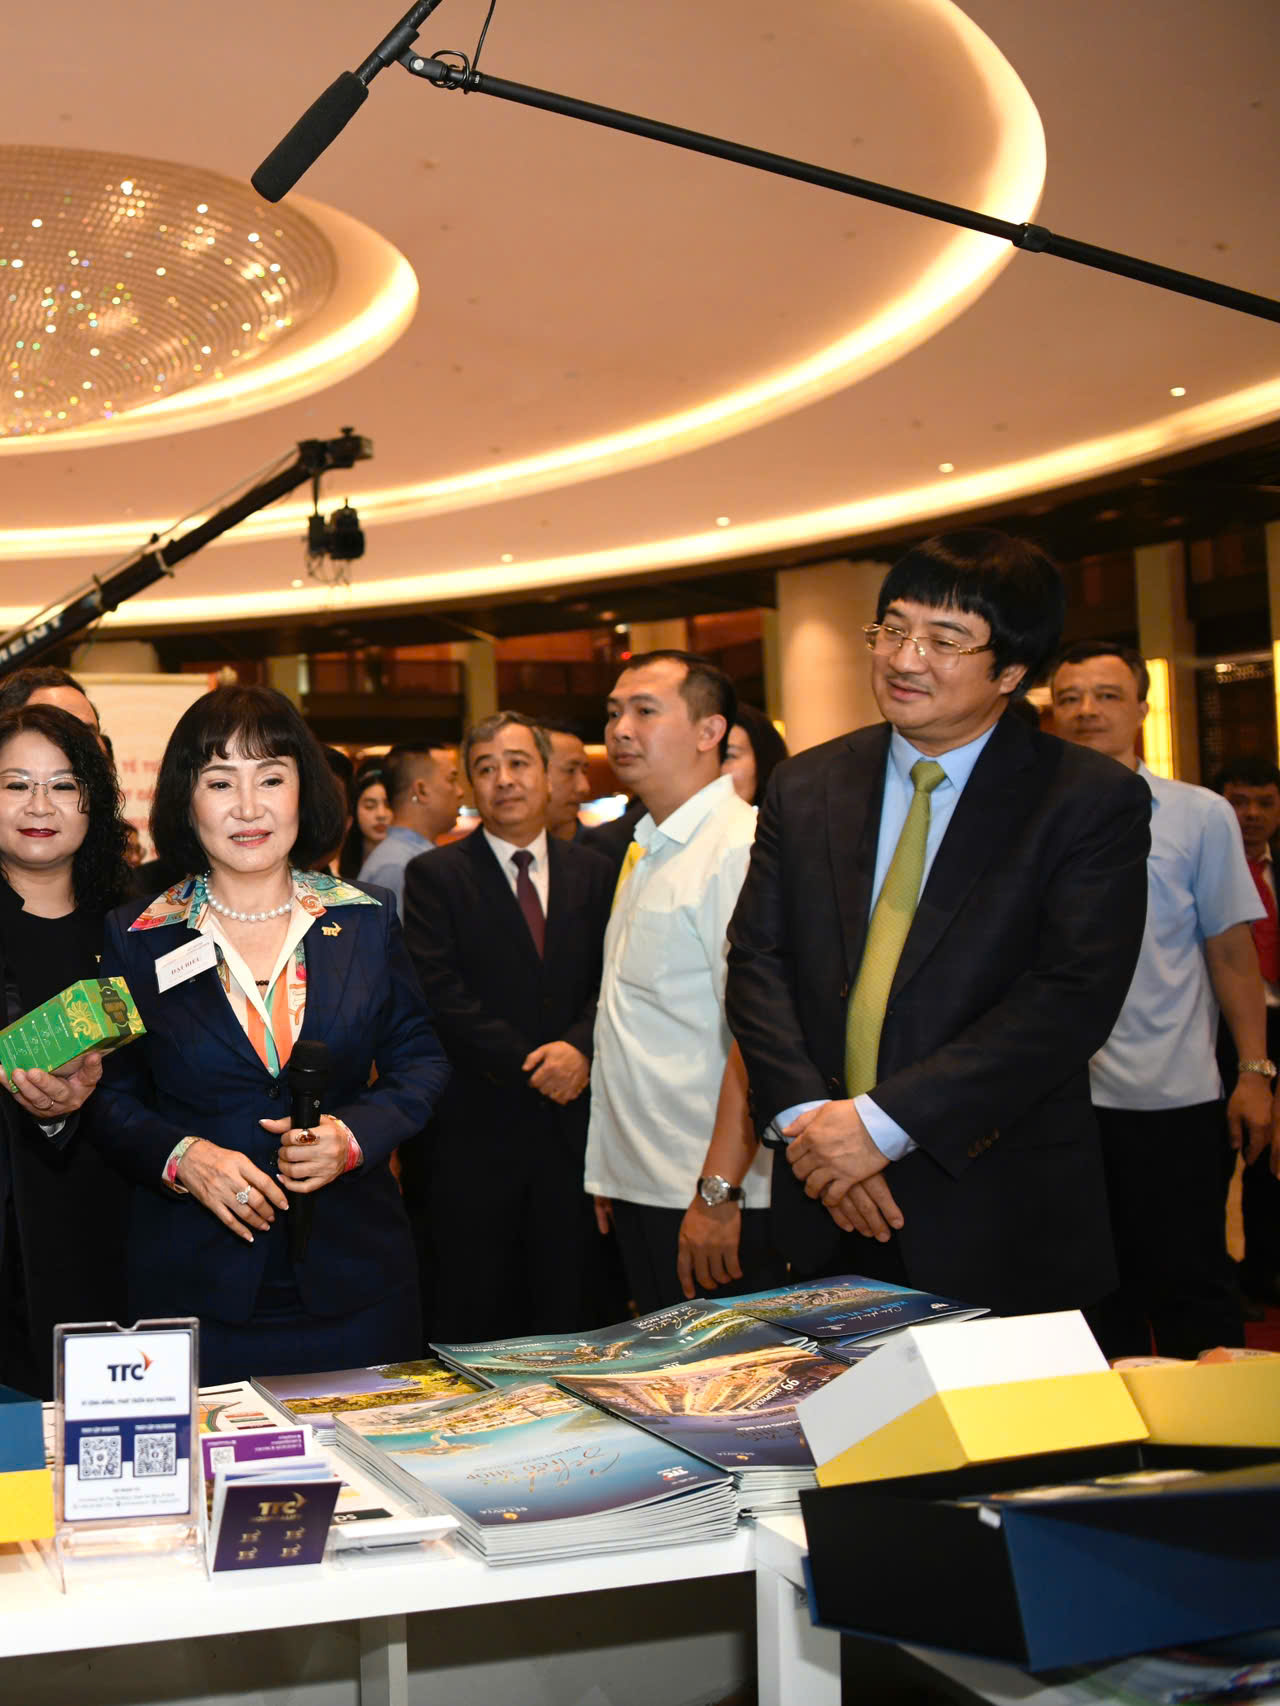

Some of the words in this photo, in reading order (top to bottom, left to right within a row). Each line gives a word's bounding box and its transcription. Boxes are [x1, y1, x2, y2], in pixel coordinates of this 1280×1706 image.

[107, 1362, 145, 1382] TTC
[780, 1377, 800, 1392] 99
[750, 1386, 783, 1411] SHOPHOUSE
[258, 1500, 297, 1516] TTC
